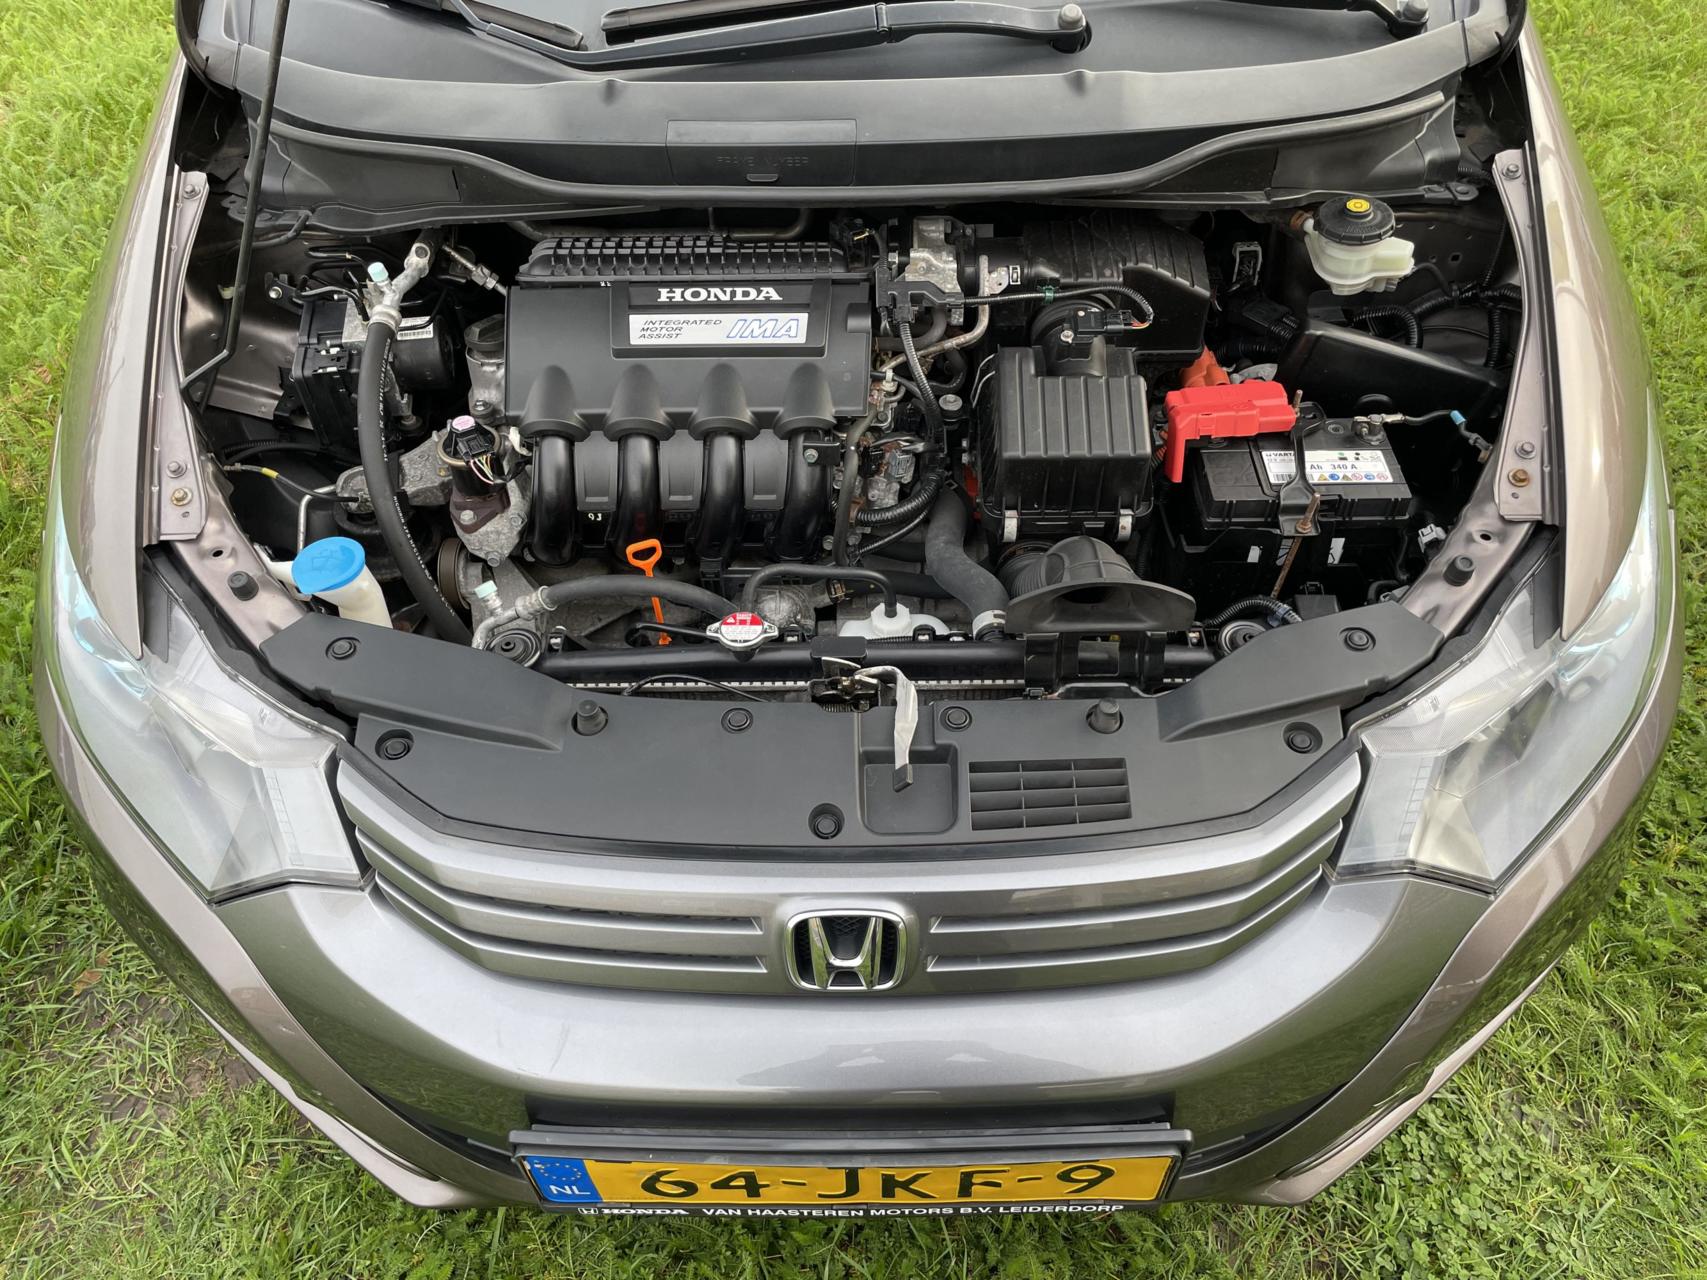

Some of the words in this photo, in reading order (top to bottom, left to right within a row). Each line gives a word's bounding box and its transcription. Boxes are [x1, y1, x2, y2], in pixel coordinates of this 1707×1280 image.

[657, 287, 783, 302] HONDA
[727, 319, 799, 339] IMA
[640, 1164, 1116, 1199] 64-JKF-9
[549, 1184, 591, 1196] NL
[702, 1208, 742, 1217] VAN
[747, 1208, 864, 1217] HAASTEREN
[870, 1207, 954, 1216] MOTORS
[959, 1206, 994, 1215] B.V.
[999, 1205, 1125, 1214] LEIDERDORP
